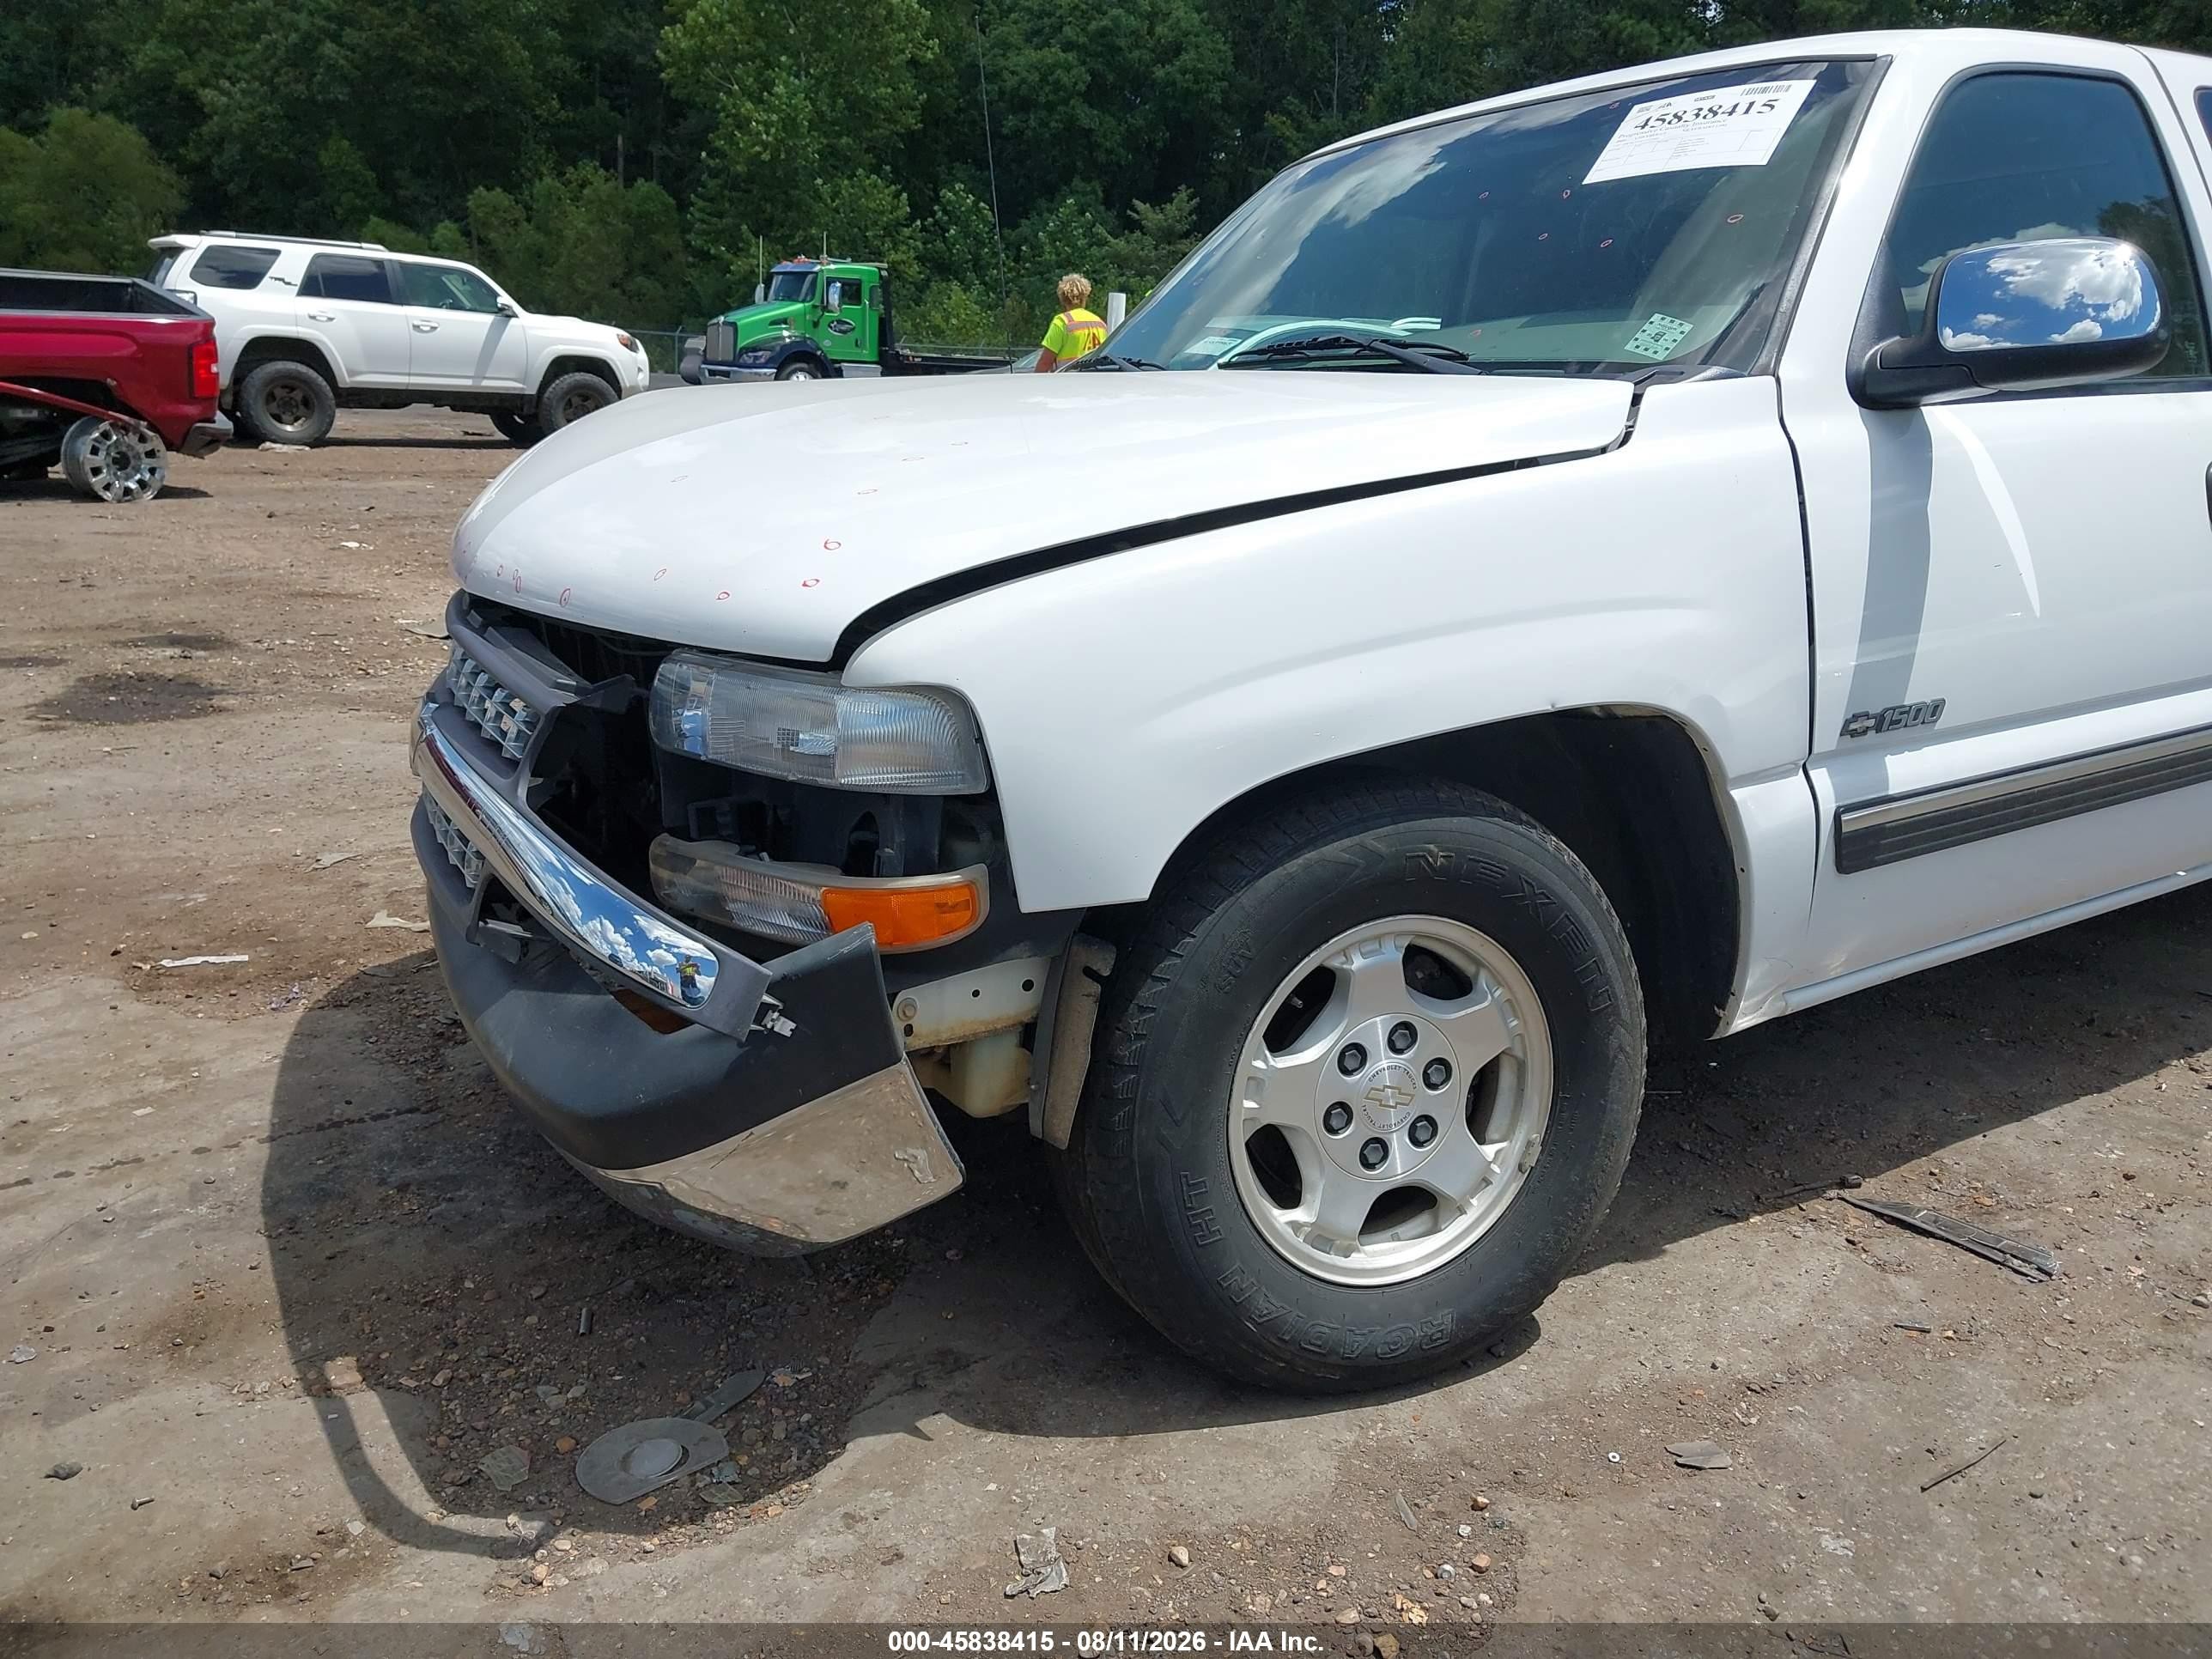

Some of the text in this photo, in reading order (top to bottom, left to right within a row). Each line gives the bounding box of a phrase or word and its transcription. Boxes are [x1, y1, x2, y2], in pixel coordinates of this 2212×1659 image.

[1634, 98, 1781, 131] 45838415
[1878, 698, 1946, 732] 1500
[1405, 851, 1613, 1012] NEXEN
[1368, 1065, 1417, 1090] CHEVROLET TRUCKS
[1180, 1171, 1456, 1360] ROADIAN HT
